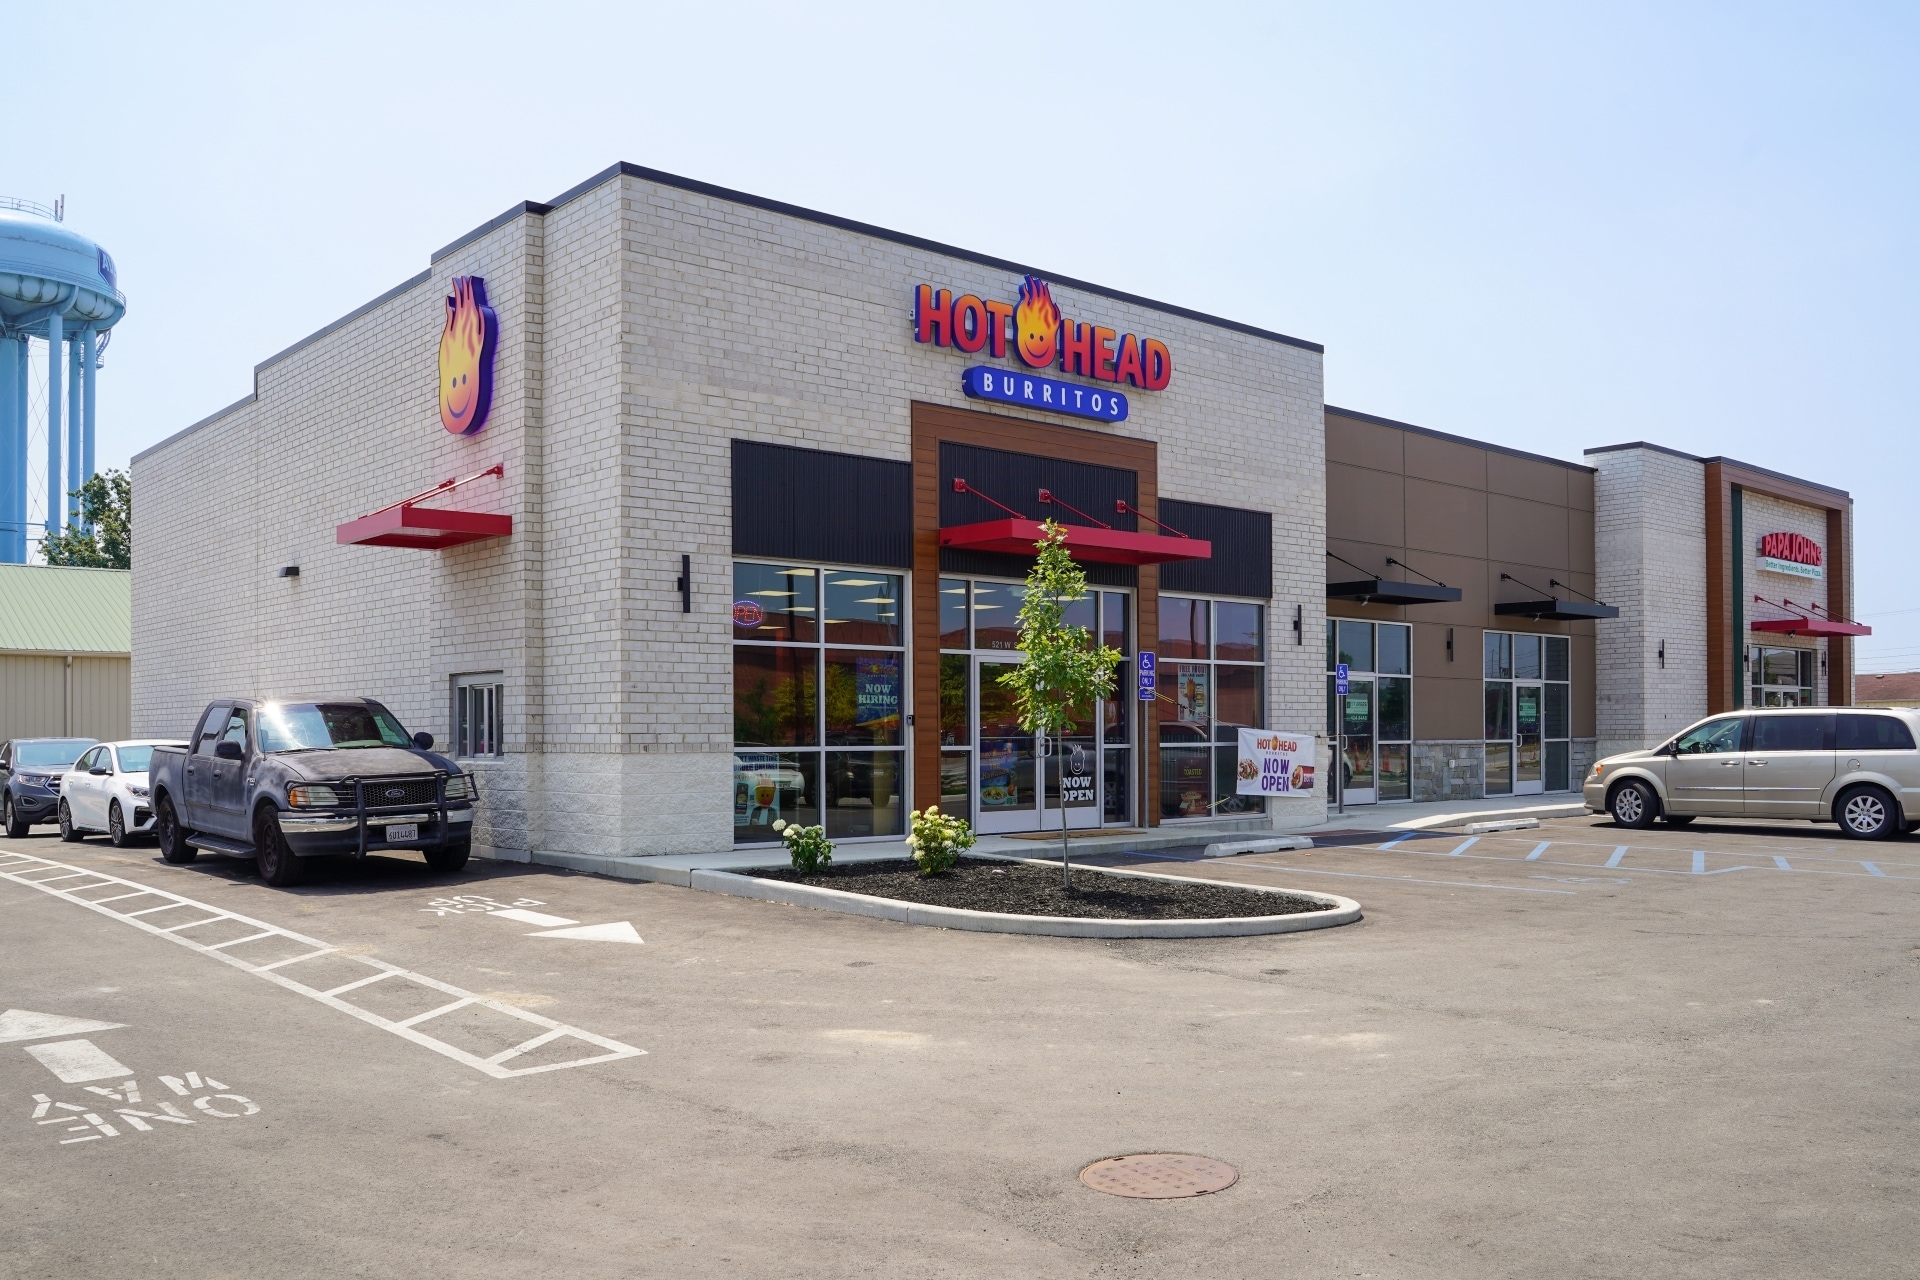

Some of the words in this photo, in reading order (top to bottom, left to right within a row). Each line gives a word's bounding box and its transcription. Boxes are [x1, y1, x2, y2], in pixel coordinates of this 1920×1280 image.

[915, 284, 1013, 358] HOT
[1060, 318, 1171, 391] HEAD
[983, 373, 1119, 415] BURRITOS
[1763, 532, 1790, 559] PAPA
[1791, 533, 1822, 566] JOHNS
[1765, 559, 1778, 568] Better
[1800, 566, 1811, 575] Better
[992, 641, 1003, 649] 521
[865, 684, 892, 694] NOW
[858, 694, 899, 704] HIRING
[1257, 738, 1271, 750] HOT
[1278, 741, 1297, 752] HEAD
[1263, 758, 1289, 774] NOW
[1062, 776, 1092, 788] NOW
[1262, 775, 1289, 791] OPEN
